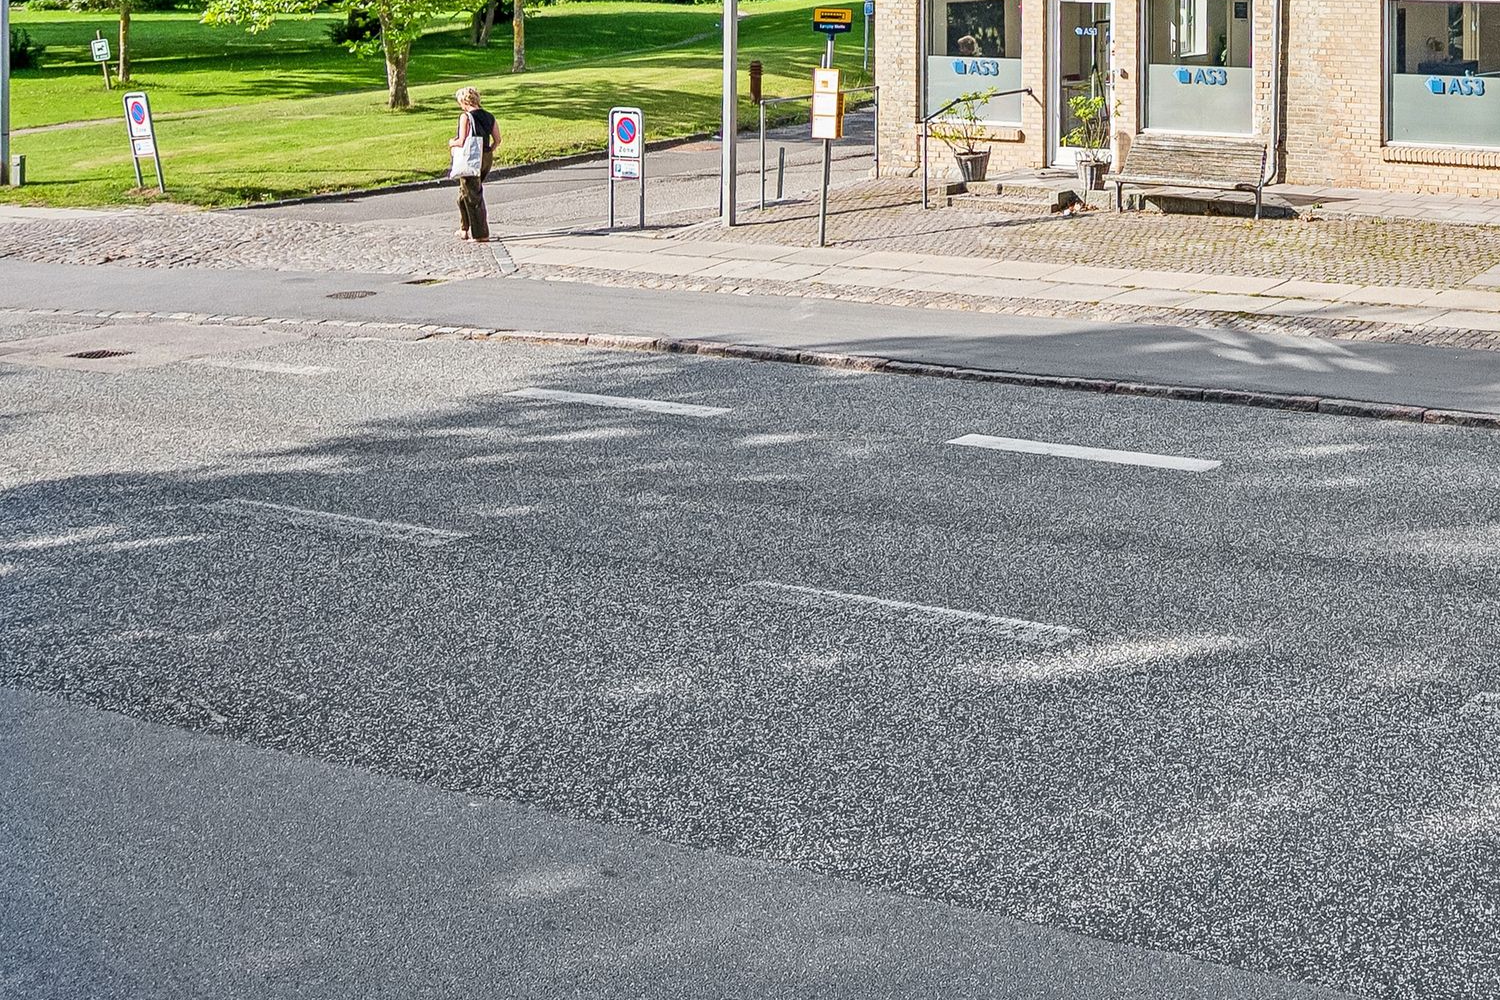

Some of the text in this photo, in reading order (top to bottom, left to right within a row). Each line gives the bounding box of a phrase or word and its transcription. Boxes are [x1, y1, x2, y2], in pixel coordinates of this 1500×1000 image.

[969, 59, 1000, 77] AS3
[1194, 67, 1228, 86] AS3
[1448, 77, 1486, 97] AS3
